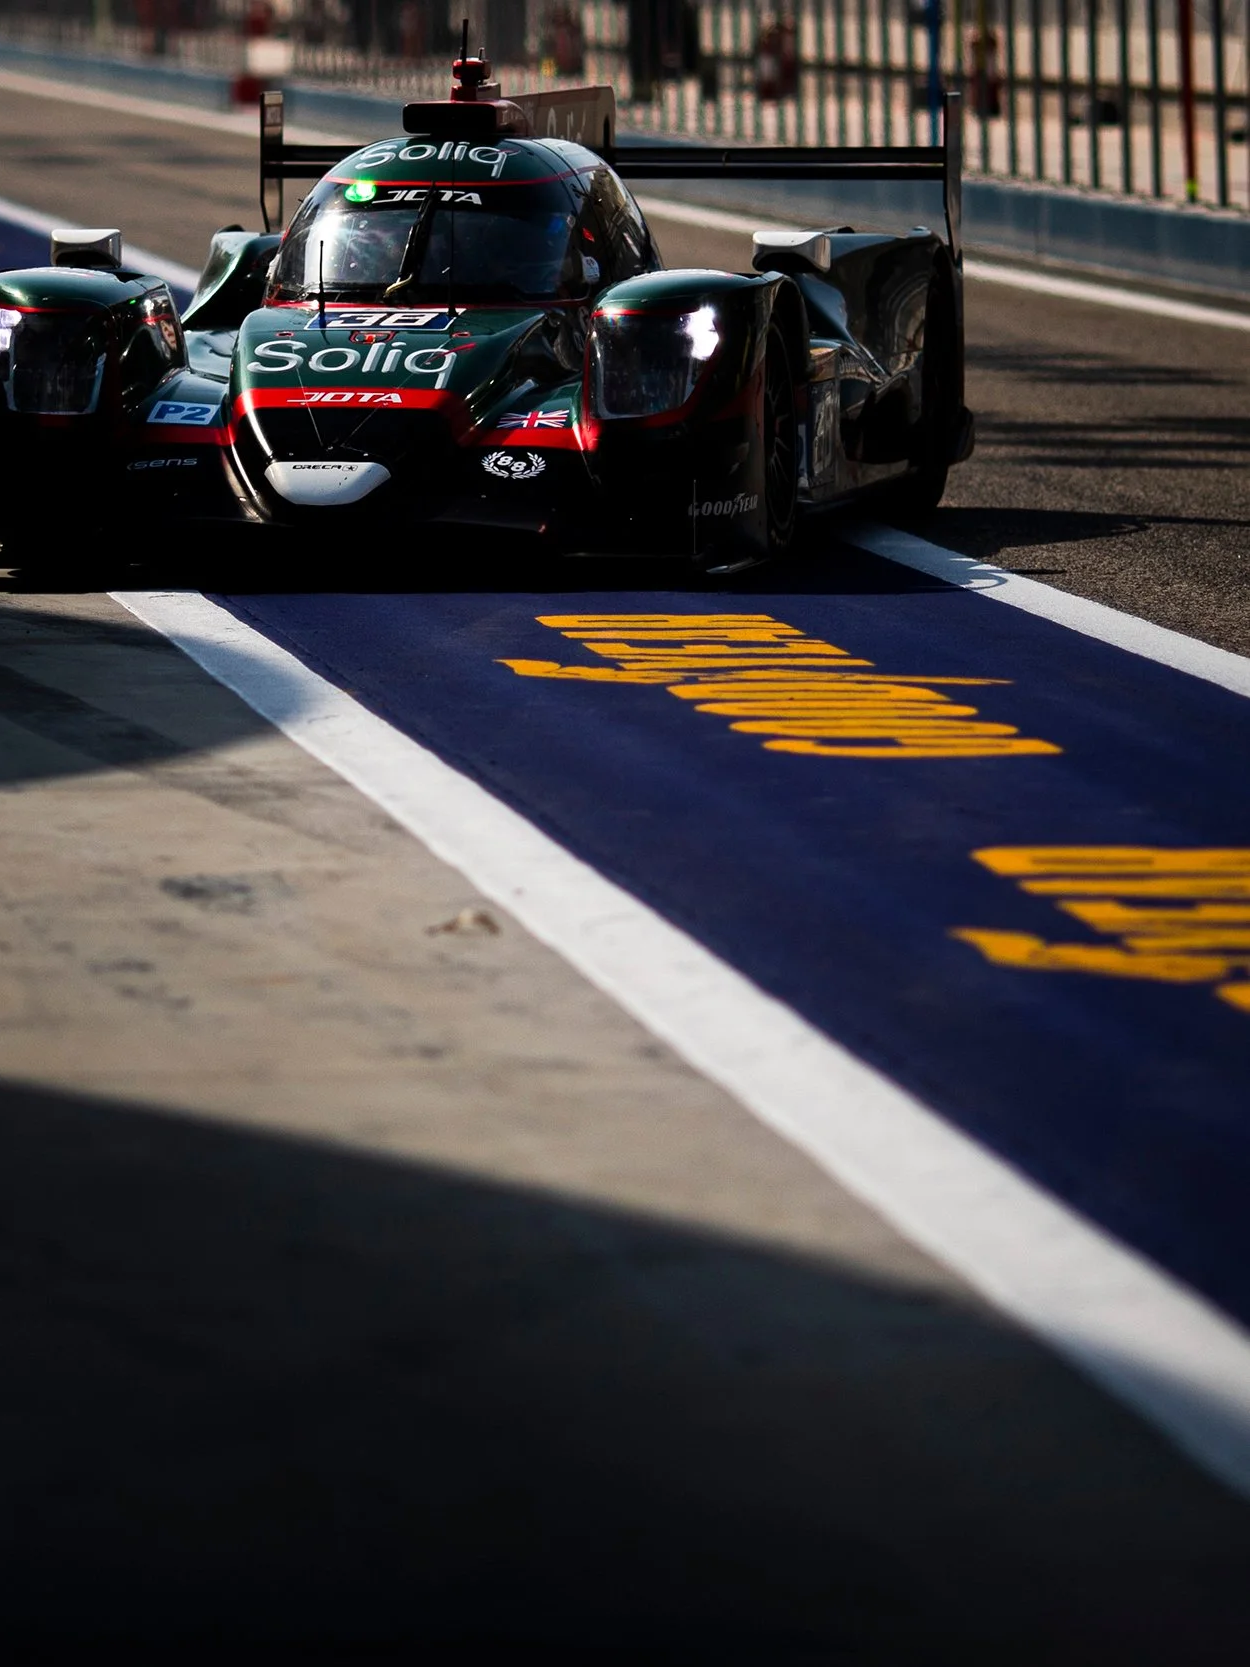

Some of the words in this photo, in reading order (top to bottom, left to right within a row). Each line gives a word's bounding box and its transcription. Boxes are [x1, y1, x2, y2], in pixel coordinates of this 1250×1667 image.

[354, 140, 508, 179] Soliq
[371, 189, 482, 205] JOTA
[326, 313, 444, 328] 38
[248, 340, 458, 389] Soliq
[286, 392, 403, 404] JOTA
[154, 404, 211, 421] P2
